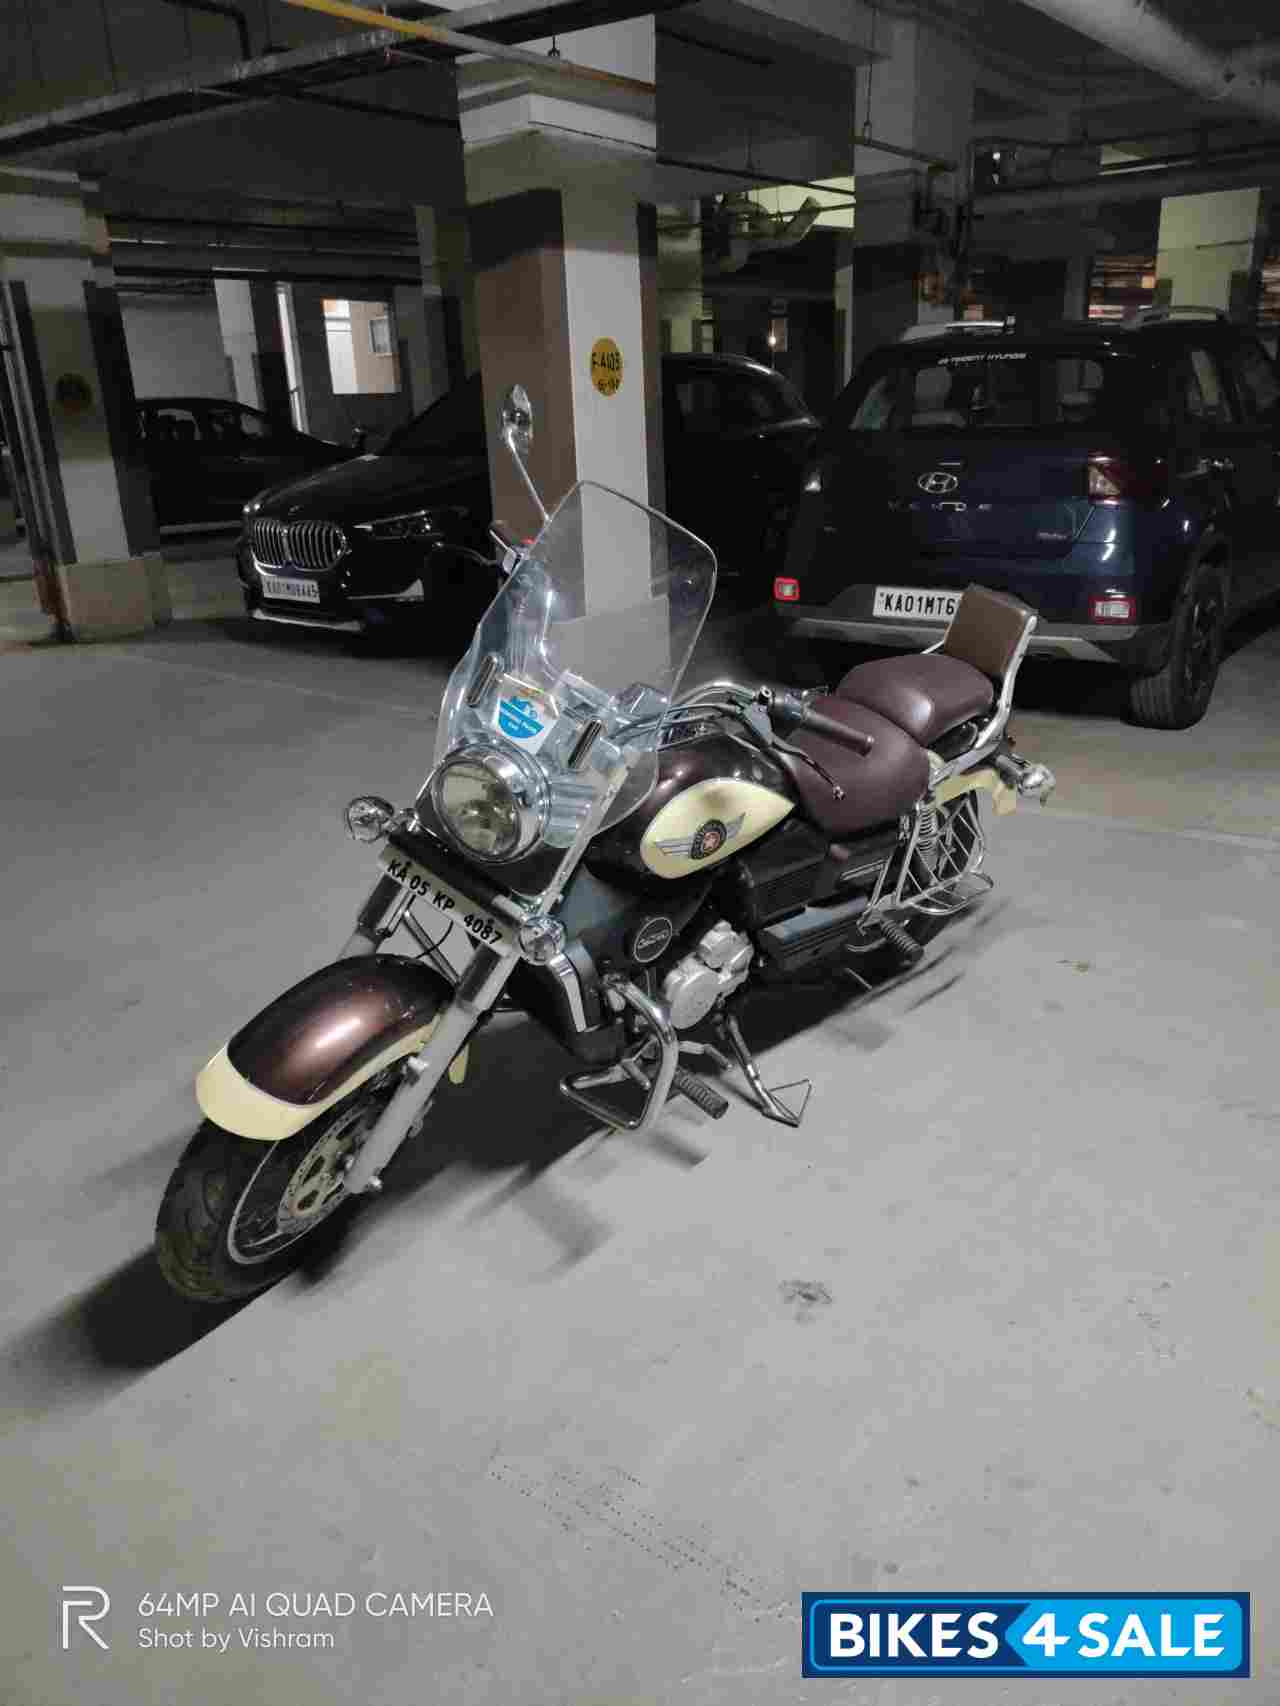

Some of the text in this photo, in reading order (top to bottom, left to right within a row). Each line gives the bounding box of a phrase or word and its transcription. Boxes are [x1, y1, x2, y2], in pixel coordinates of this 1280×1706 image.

[387, 859, 503, 945] KA 05 KP 4087
